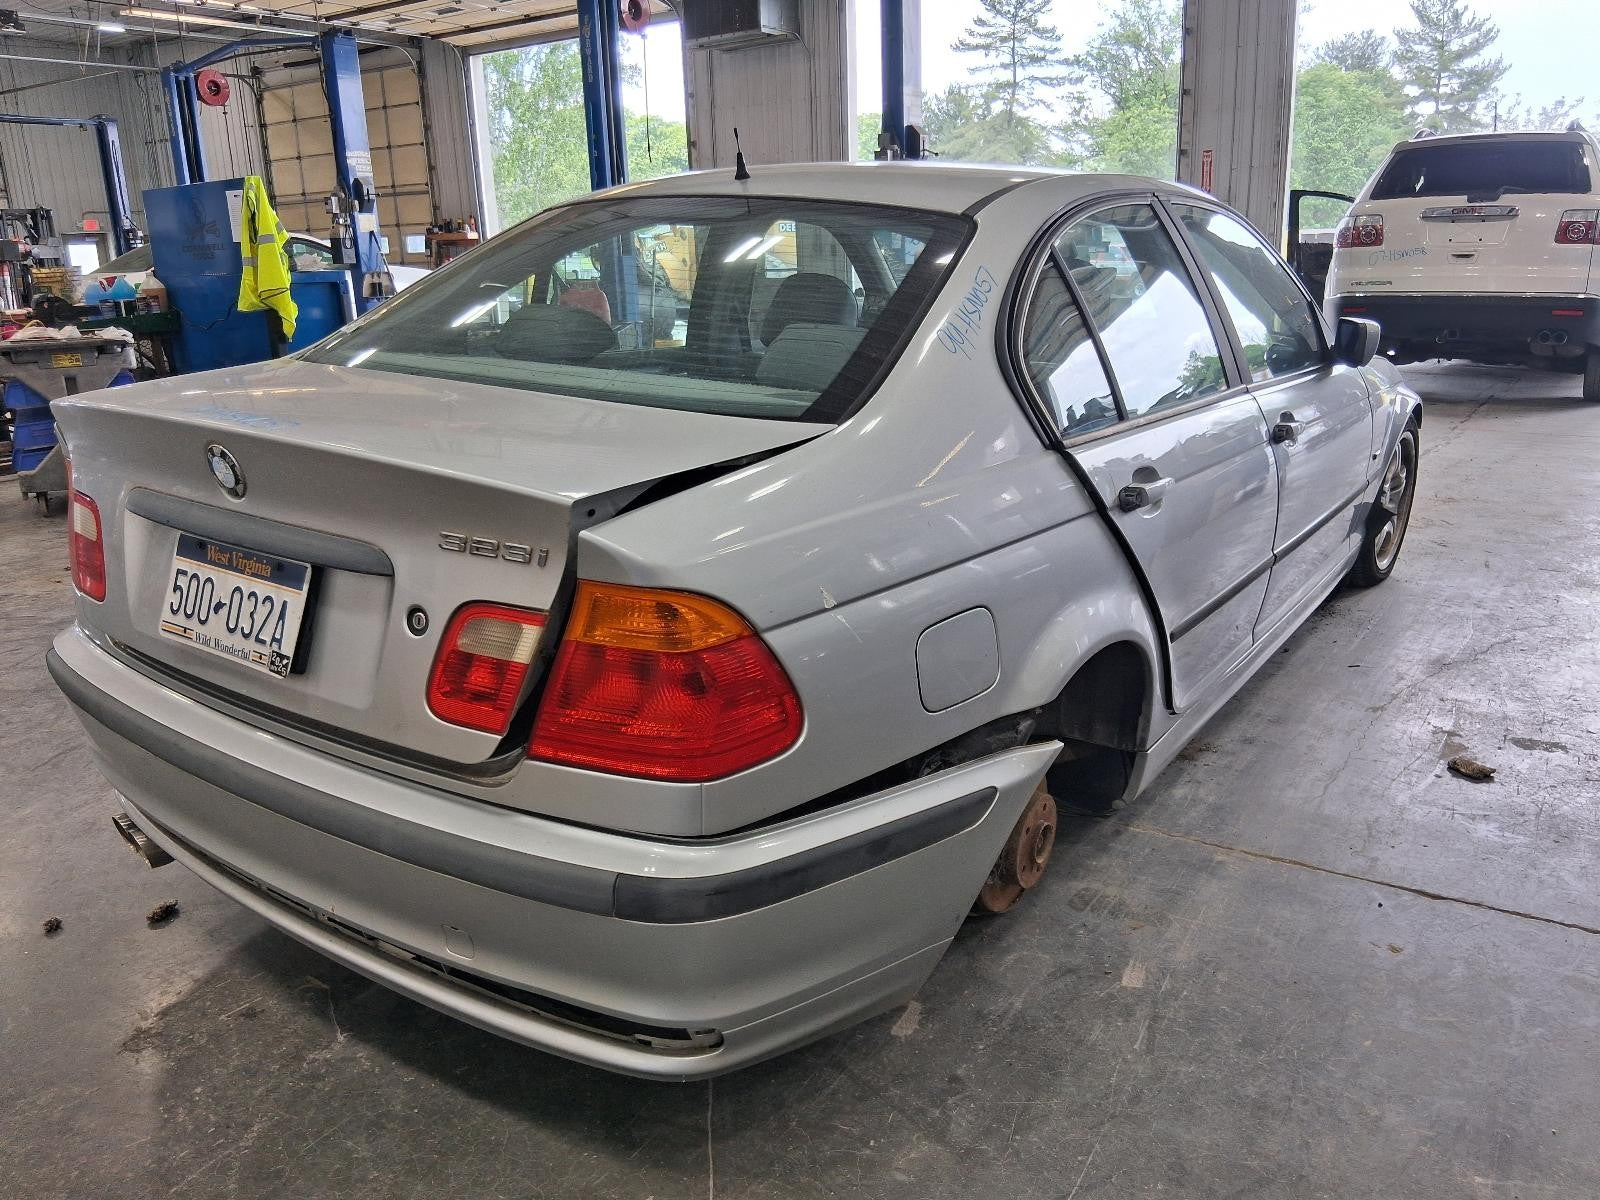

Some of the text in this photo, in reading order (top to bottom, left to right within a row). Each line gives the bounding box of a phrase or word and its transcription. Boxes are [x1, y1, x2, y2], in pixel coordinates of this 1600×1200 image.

[1451, 207, 1485, 215] GMC
[207, 544, 272, 576] West Virginia
[438, 530, 549, 568] 323i
[195, 631, 251, 660] Wild Wonderful
